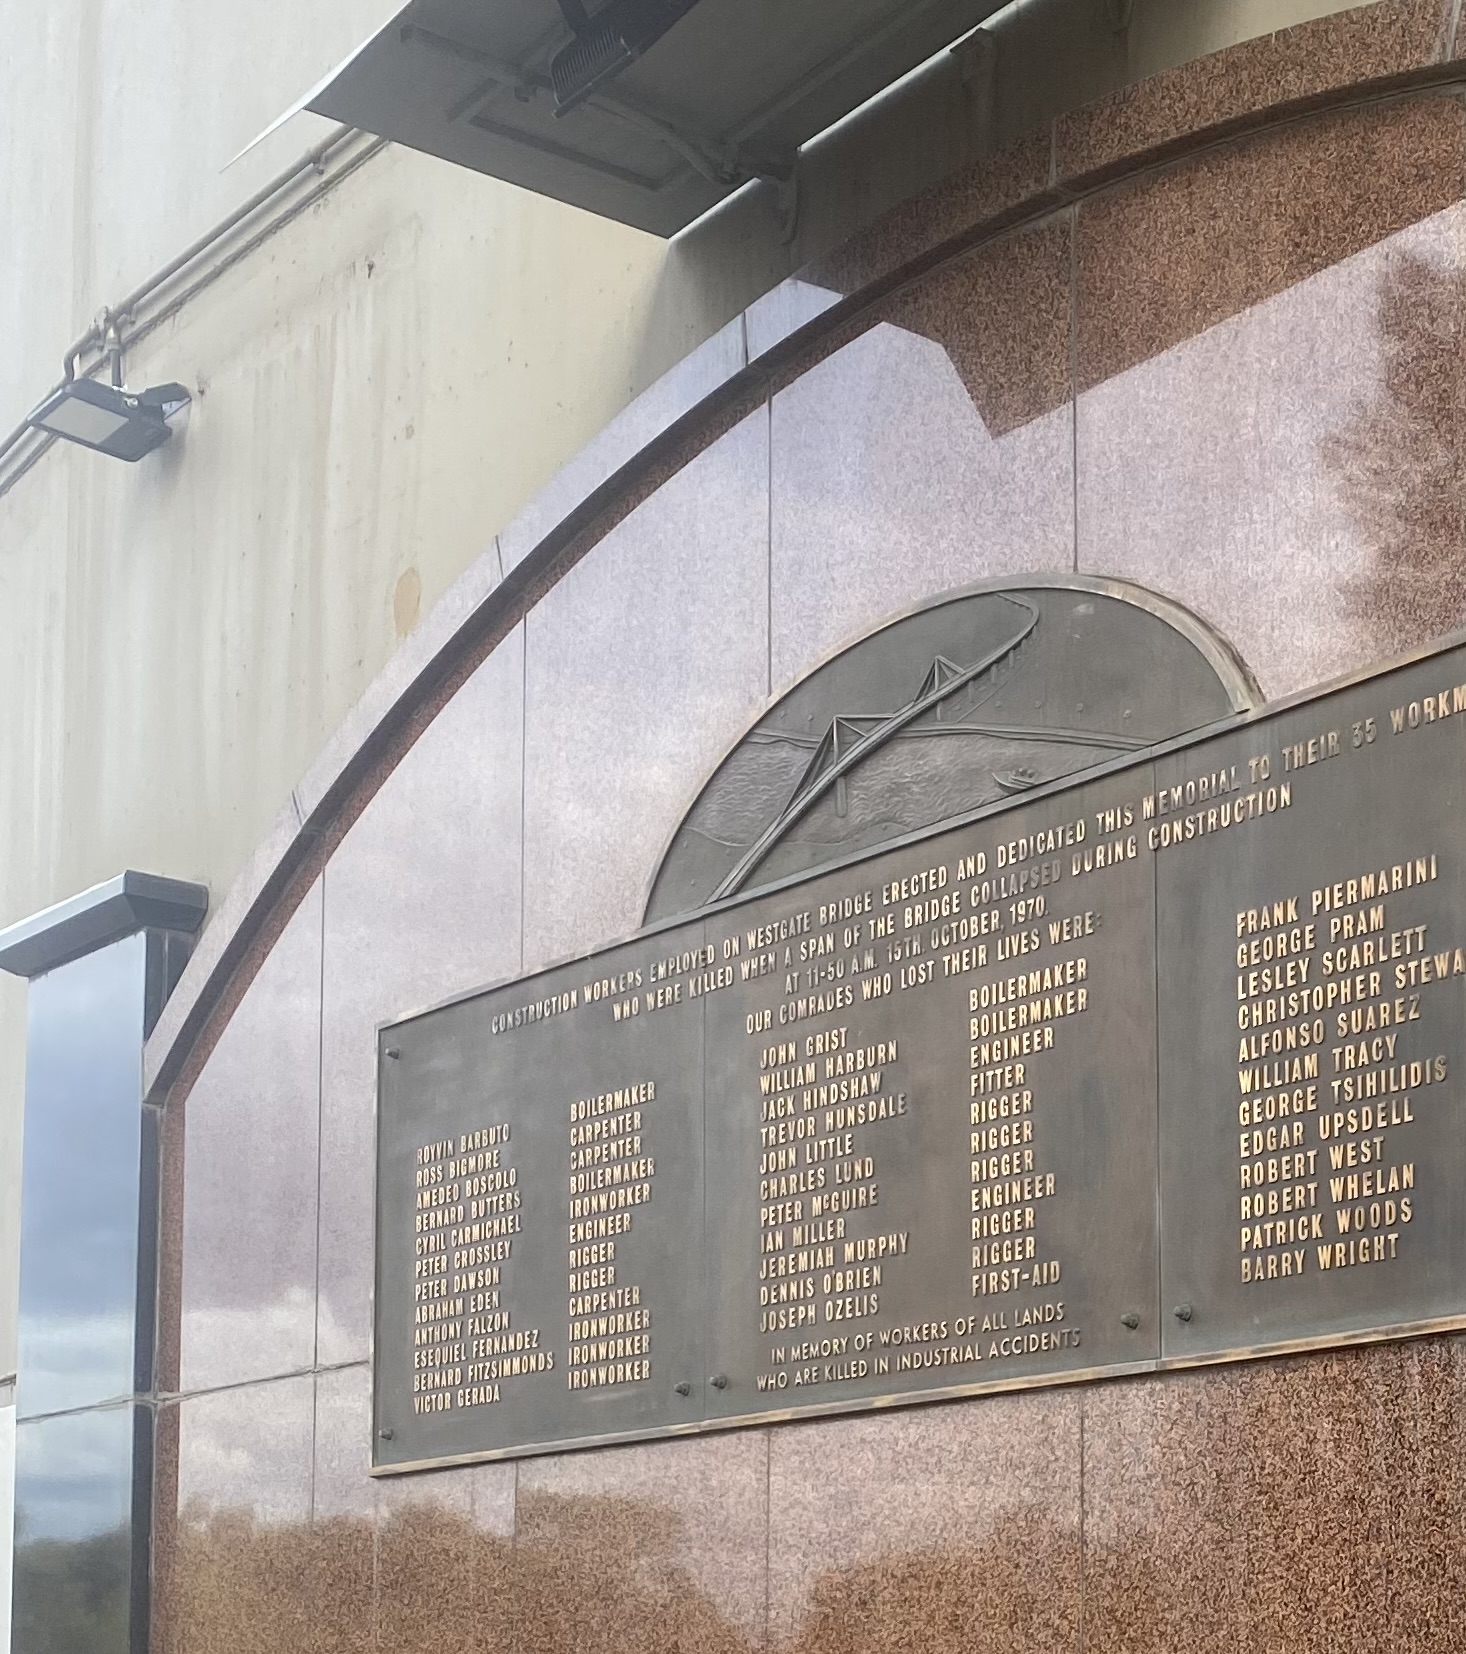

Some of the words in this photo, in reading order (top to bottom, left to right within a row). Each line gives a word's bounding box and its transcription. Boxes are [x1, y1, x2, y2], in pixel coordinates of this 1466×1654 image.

[492, 989, 578, 1034] CONSTRUCTION
[584, 968, 642, 1002] WORKERS
[650, 944, 714, 983] EMPLOYED
[723, 936, 739, 959] ON
[747, 911, 811, 951] WESTGATE
[819, 890, 872, 926] BRIDGE
[882, 866, 948, 906] ERECTED
[957, 852, 986, 881] AND
[998, 819, 1086, 868] DEDICATED
[1096, 803, 1133, 835] THIS
[1142, 766, 1240, 820] MEMORIAL
[1249, 753, 1270, 784] TO
[1282, 729, 1340, 773] THEIR
[1352, 717, 1376, 749] 35
[612, 996, 639, 1022] WHO
[646, 983, 681, 1012] WERE
[689, 965, 734, 999] KILLED
[741, 951, 776, 981] WHEN
[785, 948, 792, 968] A
[800, 933, 834, 962] SPAN
[844, 924, 861, 949] OF
[869, 912, 894, 942] THE
[904, 891, 961, 929] BRIDGE
[971, 859, 1061, 908] COLLAPSED
[1072, 835, 1137, 876] DURING
[1148, 782, 1292, 851] CONSTRUCTION
[1236, 896, 1298, 938] FRANK
[1312, 854, 1437, 915] PIERMARINI
[1237, 924, 1316, 968] GEORGE
[1330, 904, 1385, 943] PRAM
[746, 1011, 772, 1035] OUR
[779, 985, 853, 1025] COMRADES
[862, 973, 891, 1001] WHO
[901, 960, 935, 990] LOST
[942, 944, 988, 977] THEIR
[998, 928, 1039, 961] LIVES
[1238, 958, 1310, 1001] LESLEY
[1323, 925, 1428, 976] SCARLETT
[784, 972, 800, 996] AT
[969, 958, 1087, 1012] BOILERMAKER
[1238, 971, 1381, 1030] CHRISTOPHER
[970, 988, 1088, 1041] BOILERMAKER
[1239, 1019, 1324, 1064] ALFONSO
[1337, 994, 1421, 1038] SUAREZ
[760, 1042, 796, 1069] JOHN
[806, 1028, 847, 1057] GRIST
[760, 1063, 816, 1095] WILLIAM
[826, 1040, 897, 1078] HARBURN
[971, 1027, 1054, 1069] ENGINEER
[1239, 1053, 1318, 1094] WILLIAM
[1332, 1034, 1397, 1072] TRACY
[760, 1094, 795, 1122] JACK
[803, 1072, 882, 1111] HINDSHAW
[971, 1063, 1025, 1097] FITTER
[1239, 1086, 1317, 1126] GEORGE
[1331, 1055, 1446, 1105] TSIHILIDIS
[570, 1081, 655, 1122] BOILERMAKER
[760, 1117, 816, 1148] TREVOR
[826, 1093, 907, 1132] HUNSDALE
[971, 1090, 1032, 1125] RIGGER
[461, 1124, 510, 1152] BARBUTO
[570, 1111, 641, 1146] CARPENTER
[971, 1120, 1033, 1153] RIGGER
[1240, 1121, 1303, 1158] EDGAR
[1319, 1097, 1414, 1140] UPSDELL
[417, 1165, 443, 1188] ROSS
[450, 1150, 499, 1179] BIGMORE
[570, 1136, 641, 1170] CARPENTER
[760, 1147, 796, 1174] JOHN
[806, 1134, 853, 1164] LITTLE
[971, 1150, 1033, 1183] RIGGER
[1241, 1150, 1317, 1189] ROBERT
[1329, 1136, 1385, 1171] WEST
[417, 1183, 460, 1210] AMEDEO
[466, 1168, 517, 1197] BOSCOLO
[570, 1158, 655, 1194] BOILERMAKER
[760, 1168, 825, 1201] CHARLES
[836, 1157, 874, 1184] LUND
[971, 1173, 1055, 1212] ENGINEER
[1241, 1182, 1317, 1220] ROBERT
[1330, 1163, 1415, 1203] WHELAN
[416, 1205, 464, 1232] BERNARD
[472, 1190, 521, 1219] BUTTERS
[570, 1183, 651, 1219] IRONWORKER
[760, 1201, 802, 1228] PETER
[416, 1233, 446, 1255] CYRIL
[451, 1214, 522, 1247] CARMICHAEL
[569, 1213, 631, 1243] ENGINEER
[761, 1230, 783, 1254] IAN
[793, 1218, 845, 1247] MILLER
[971, 1207, 1035, 1240] RIGGER
[1241, 1213, 1323, 1251] PATRICK
[1337, 1197, 1412, 1233] WOODS
[416, 1255, 448, 1278] PETER
[454, 1240, 512, 1269] CROSSLEY
[569, 1242, 615, 1269] RIGGER
[760, 1246, 834, 1280] JEREMIAH
[845, 1232, 908, 1263] MURPHY
[972, 1236, 1035, 1269] RIGGER
[1242, 1249, 1305, 1283] BARRY
[1317, 1233, 1399, 1271] WRIGHT
[416, 1279, 447, 1302] PETER
[454, 1267, 500, 1293] DAWSON
[569, 1266, 615, 1293] RIGGER
[760, 1278, 814, 1306] DENNIS
[823, 1265, 881, 1294] O'BRIEN
[972, 1260, 1060, 1297] FIRST-AID
[415, 1298, 464, 1325] ABRAHAM
[471, 1290, 499, 1313] EDEN
[569, 1286, 640, 1316] CARPENTER
[760, 1304, 816, 1332] JOSEPH
[826, 1294, 878, 1321] OZELIS
[415, 1321, 462, 1346] ANTHONY
[468, 1312, 510, 1336] FALZON
[569, 1310, 650, 1342] IRONWORKER
[772, 1347, 785, 1365] IN
[791, 1337, 848, 1362] MEMORY
[854, 1333, 873, 1350] OF
[879, 1320, 948, 1345] WORKERS
[955, 1315, 975, 1336] OF
[982, 1314, 1008, 1333] ALL
[1014, 1303, 1064, 1327] LANDS
[415, 1343, 466, 1369] ESEQUIEL
[473, 1330, 540, 1359] FERNANDEZ
[569, 1335, 650, 1366] IRONWORKER
[757, 1372, 787, 1391] WHO
[795, 1367, 819, 1386] ARE
[824, 1360, 868, 1381] KILLED
[874, 1357, 889, 1374] IN
[897, 1343, 981, 1371] INDUSTRIAL
[989, 1328, 1081, 1358] ACCIDENTS
[414, 1367, 461, 1391] BERNARD
[468, 1352, 554, 1382] FITZSIMMONDS
[568, 1360, 650, 1390] IRONWORKER
[414, 1393, 451, 1414] VICTOR
[458, 1384, 500, 1407] GERADA
